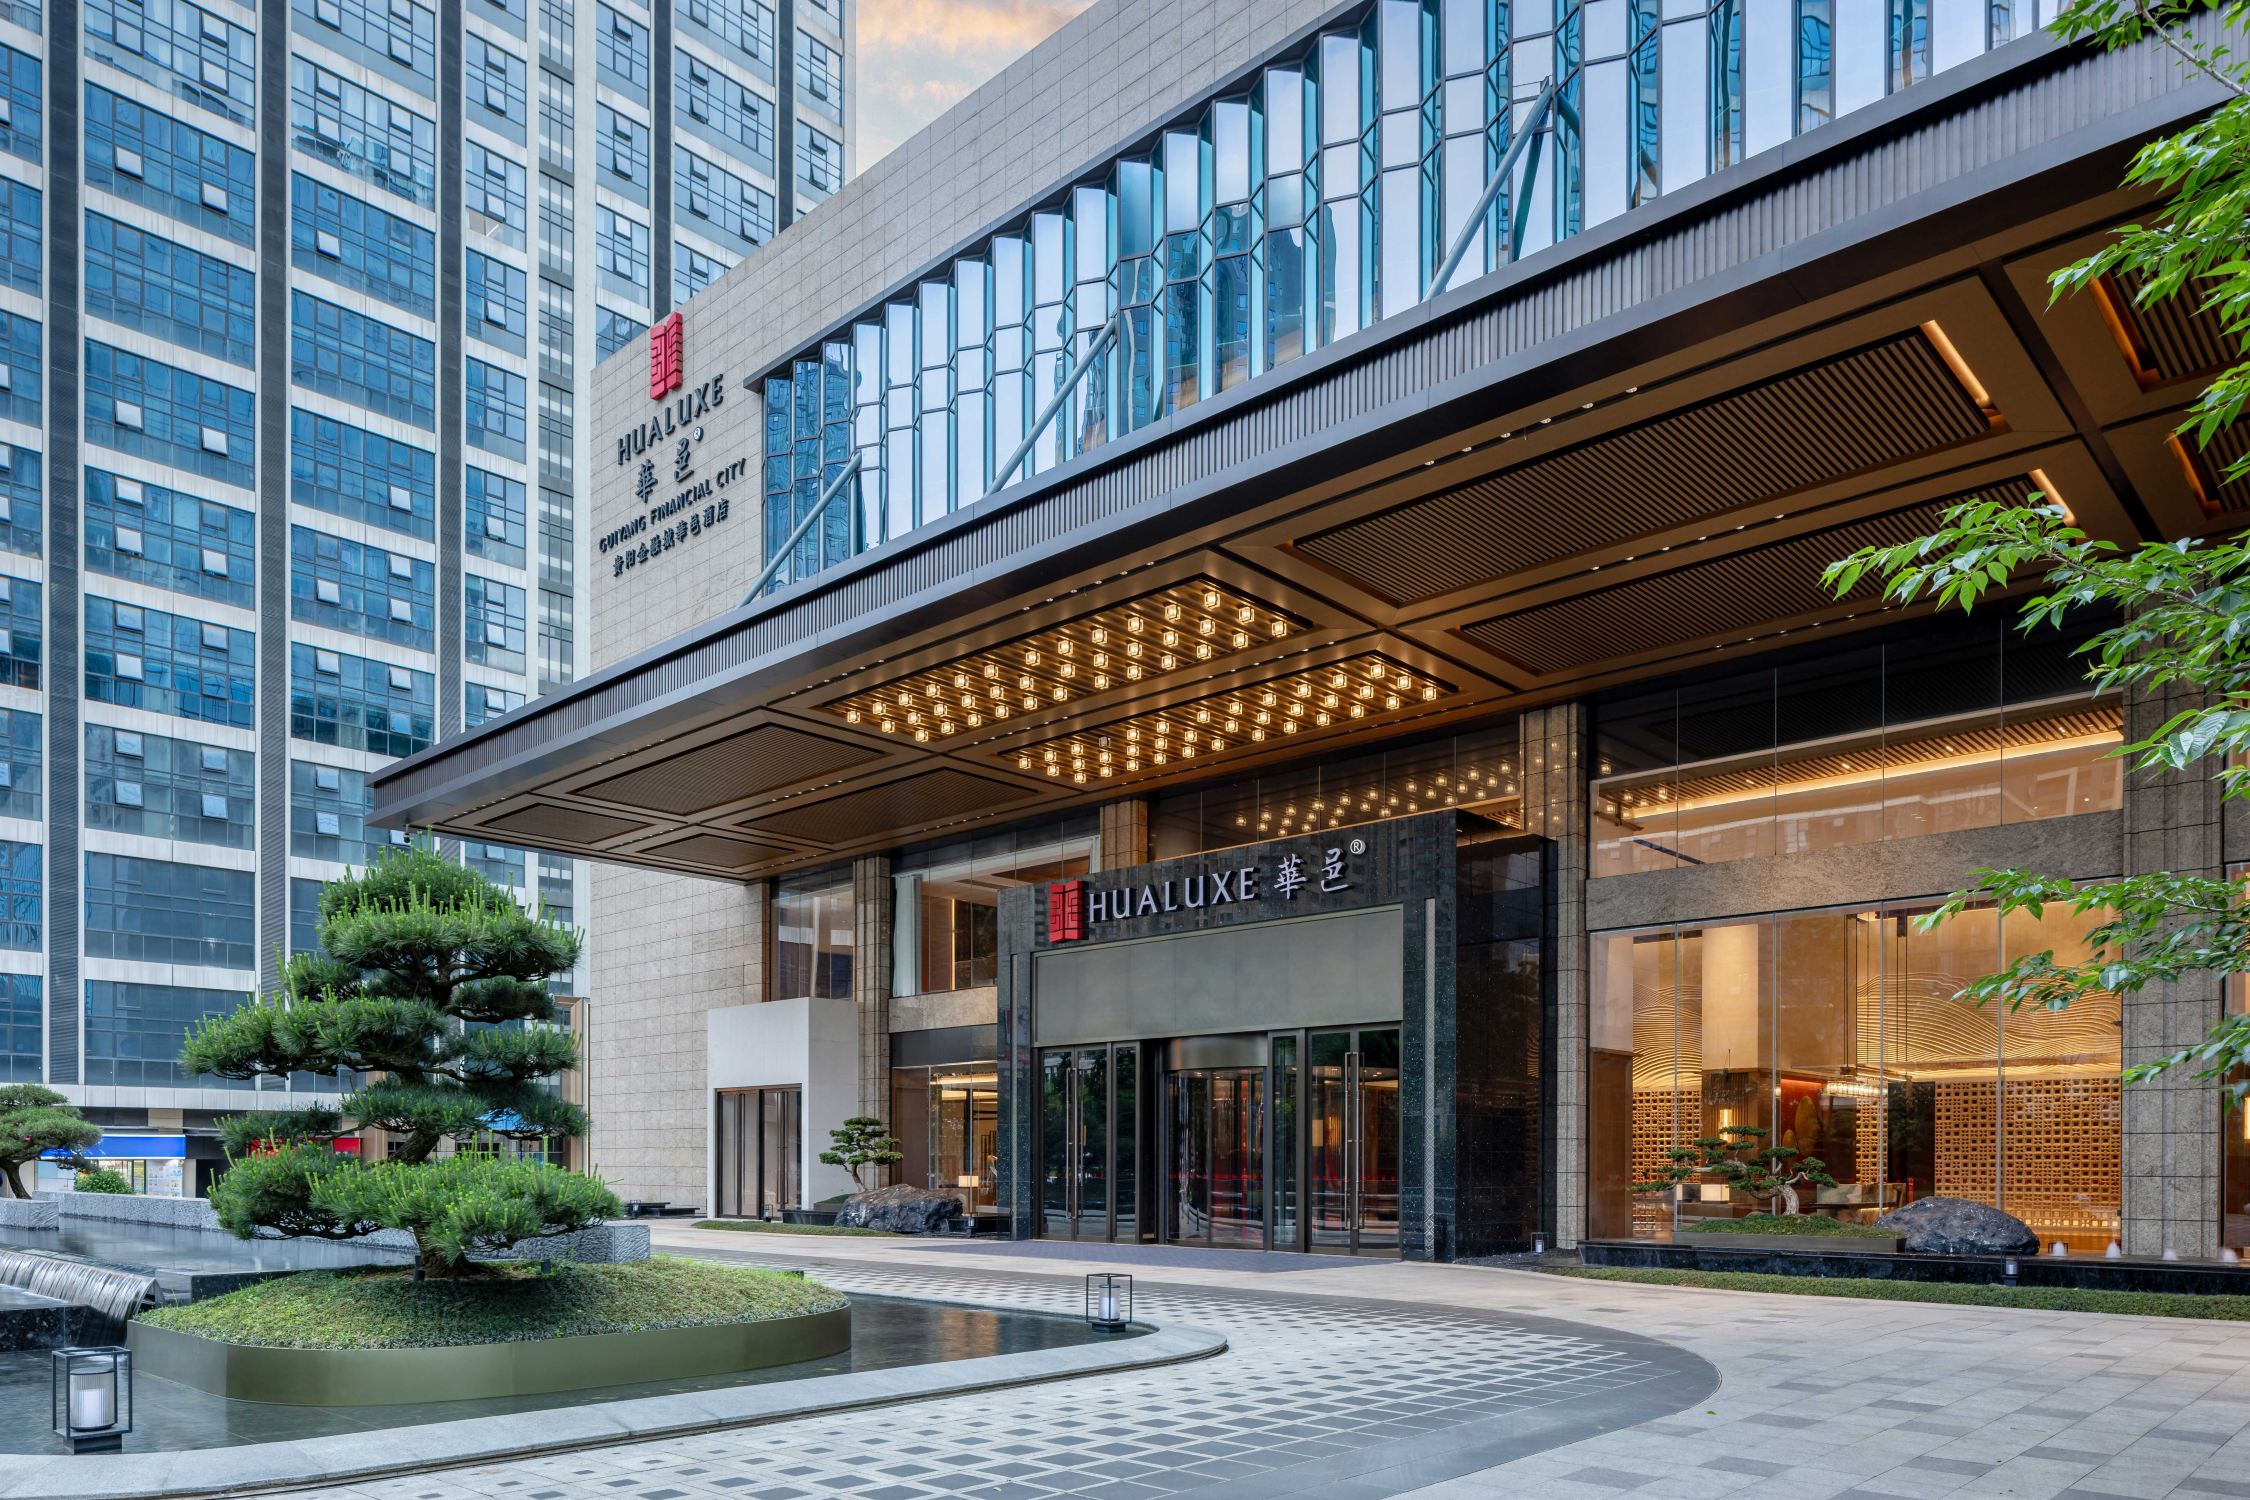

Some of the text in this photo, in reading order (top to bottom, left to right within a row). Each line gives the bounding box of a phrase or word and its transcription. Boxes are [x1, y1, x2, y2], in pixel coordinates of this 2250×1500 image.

[617, 373, 724, 466] HUALUXE
[599, 457, 747, 553] GUIYANG FINANCIAL CITY
[1088, 866, 1257, 923] HUALUXE
